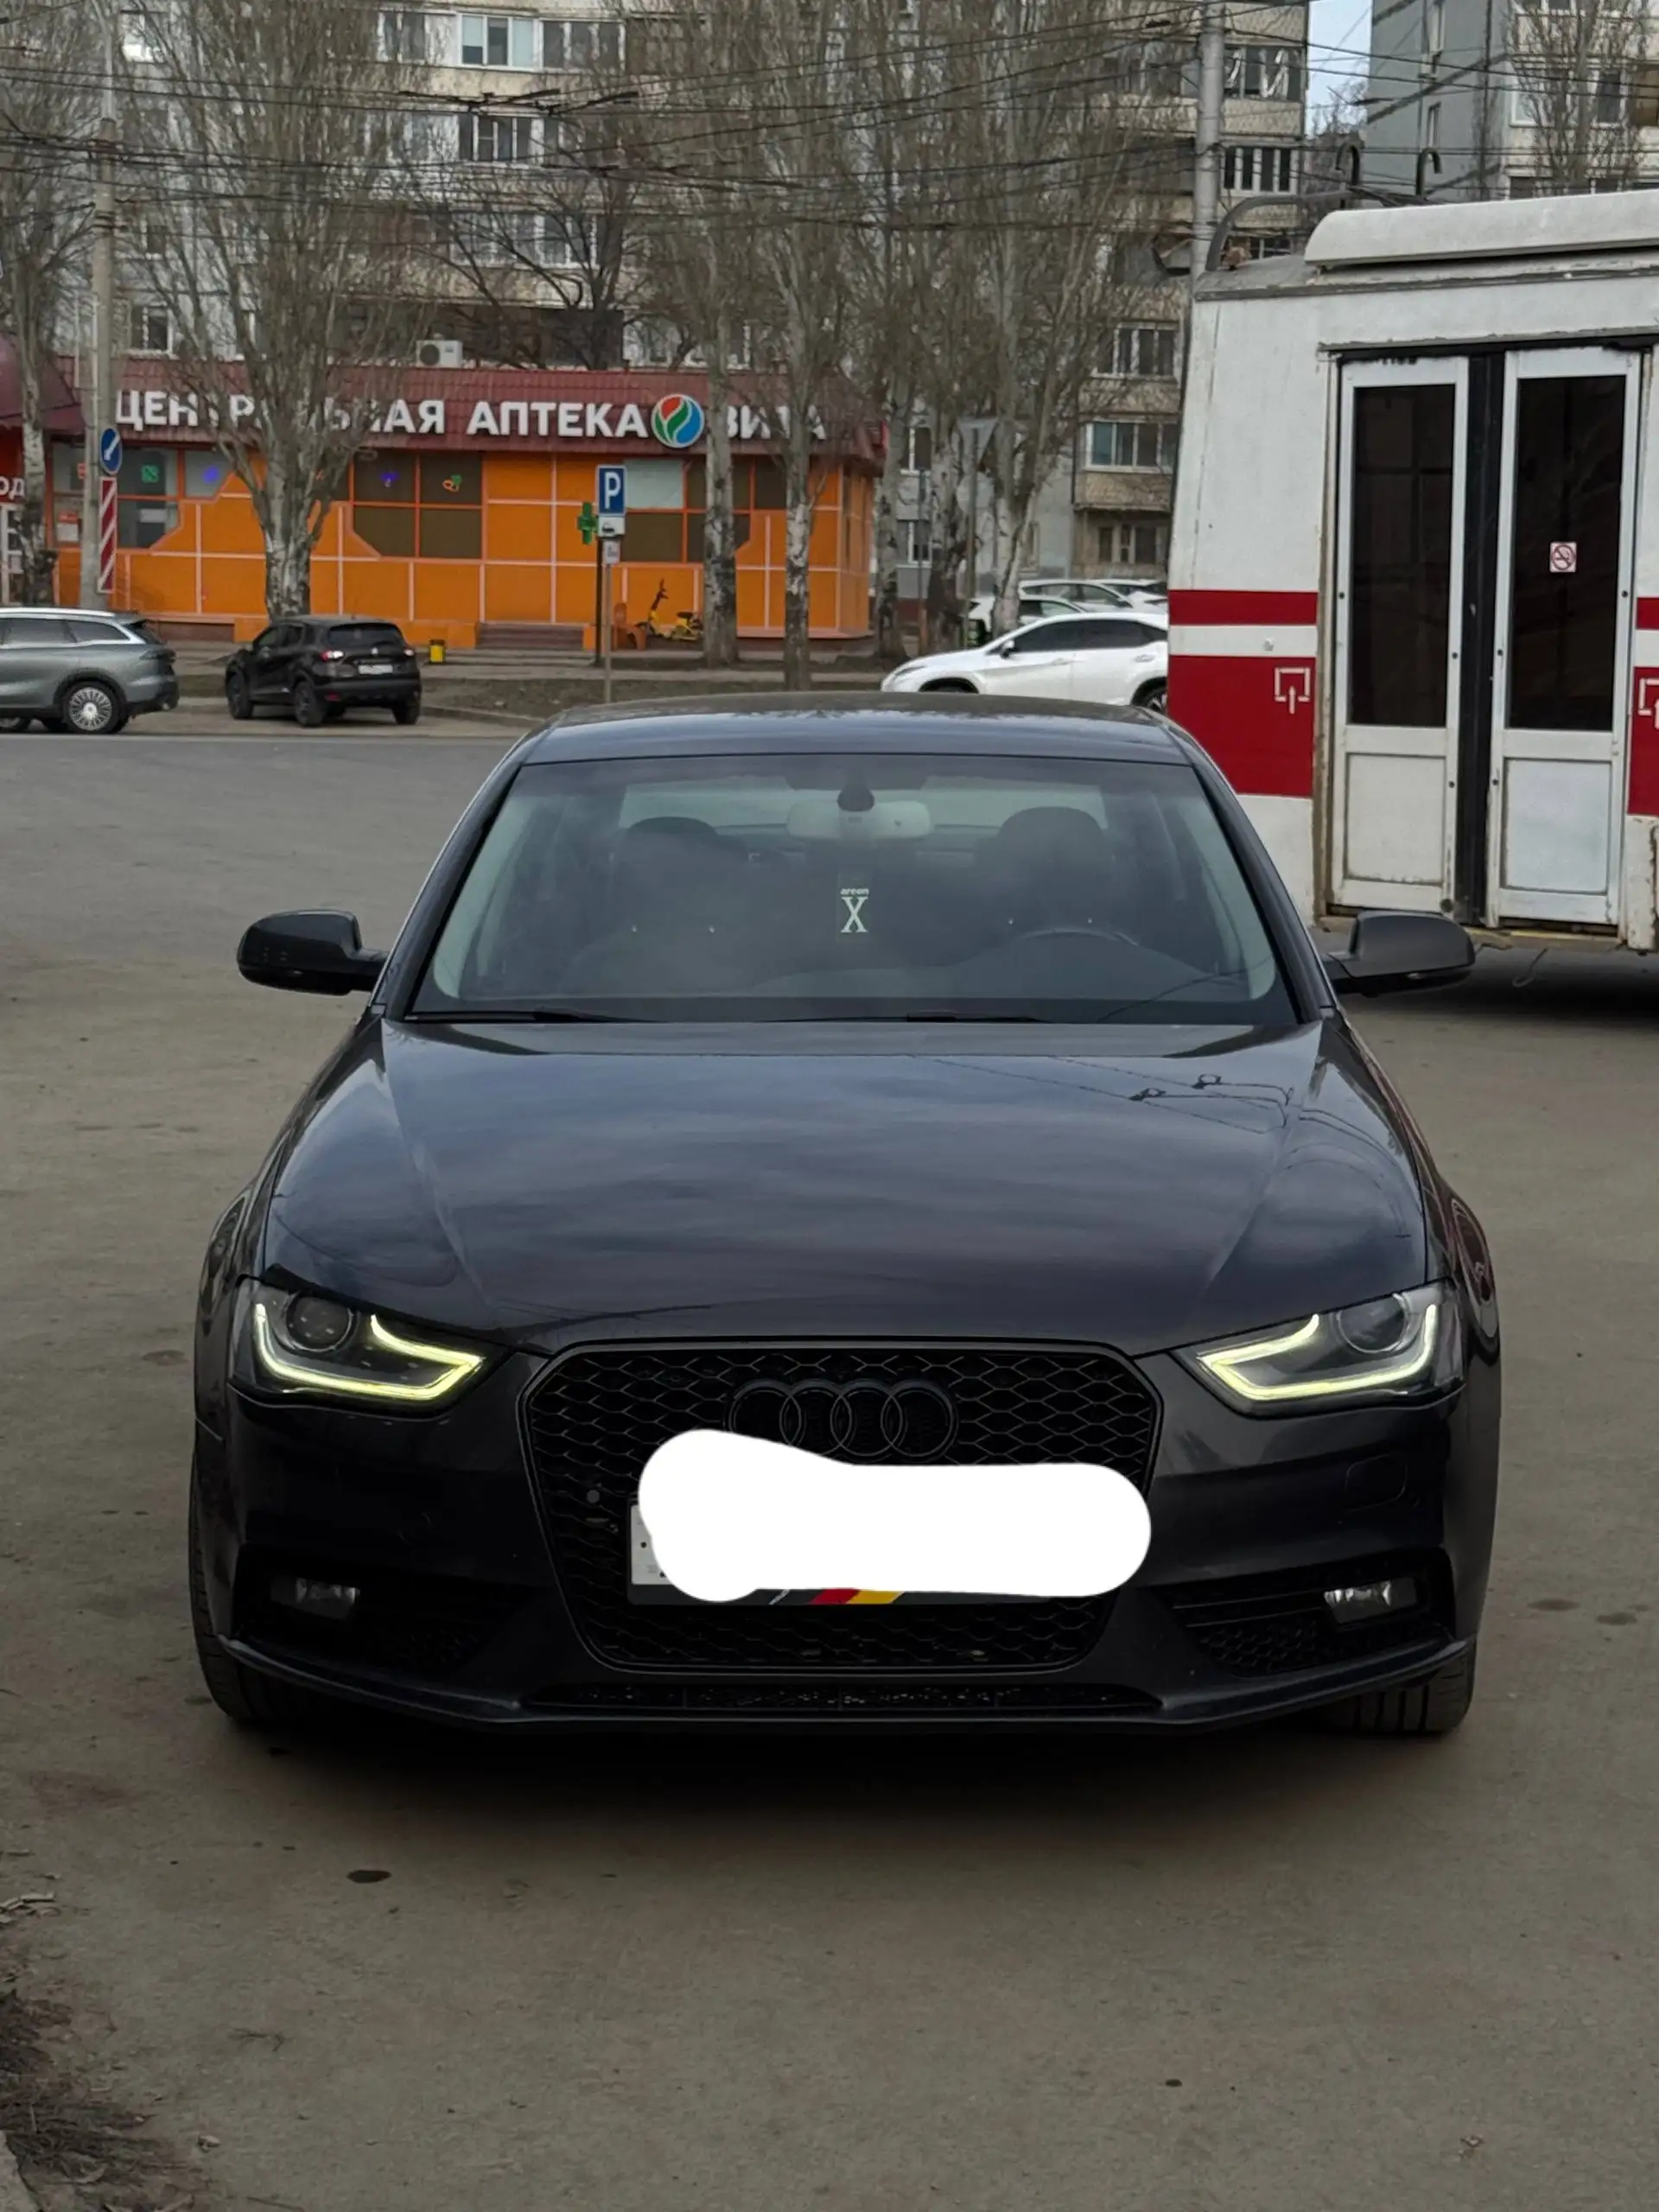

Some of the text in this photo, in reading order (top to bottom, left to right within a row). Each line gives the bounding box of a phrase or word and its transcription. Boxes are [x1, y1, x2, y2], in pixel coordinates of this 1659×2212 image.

[115, 390, 446, 435] ЦЕНРЬАЯ
[466, 400, 650, 438] АПТЕКА
[605, 471, 622, 509] P
[841, 896, 868, 933] X
